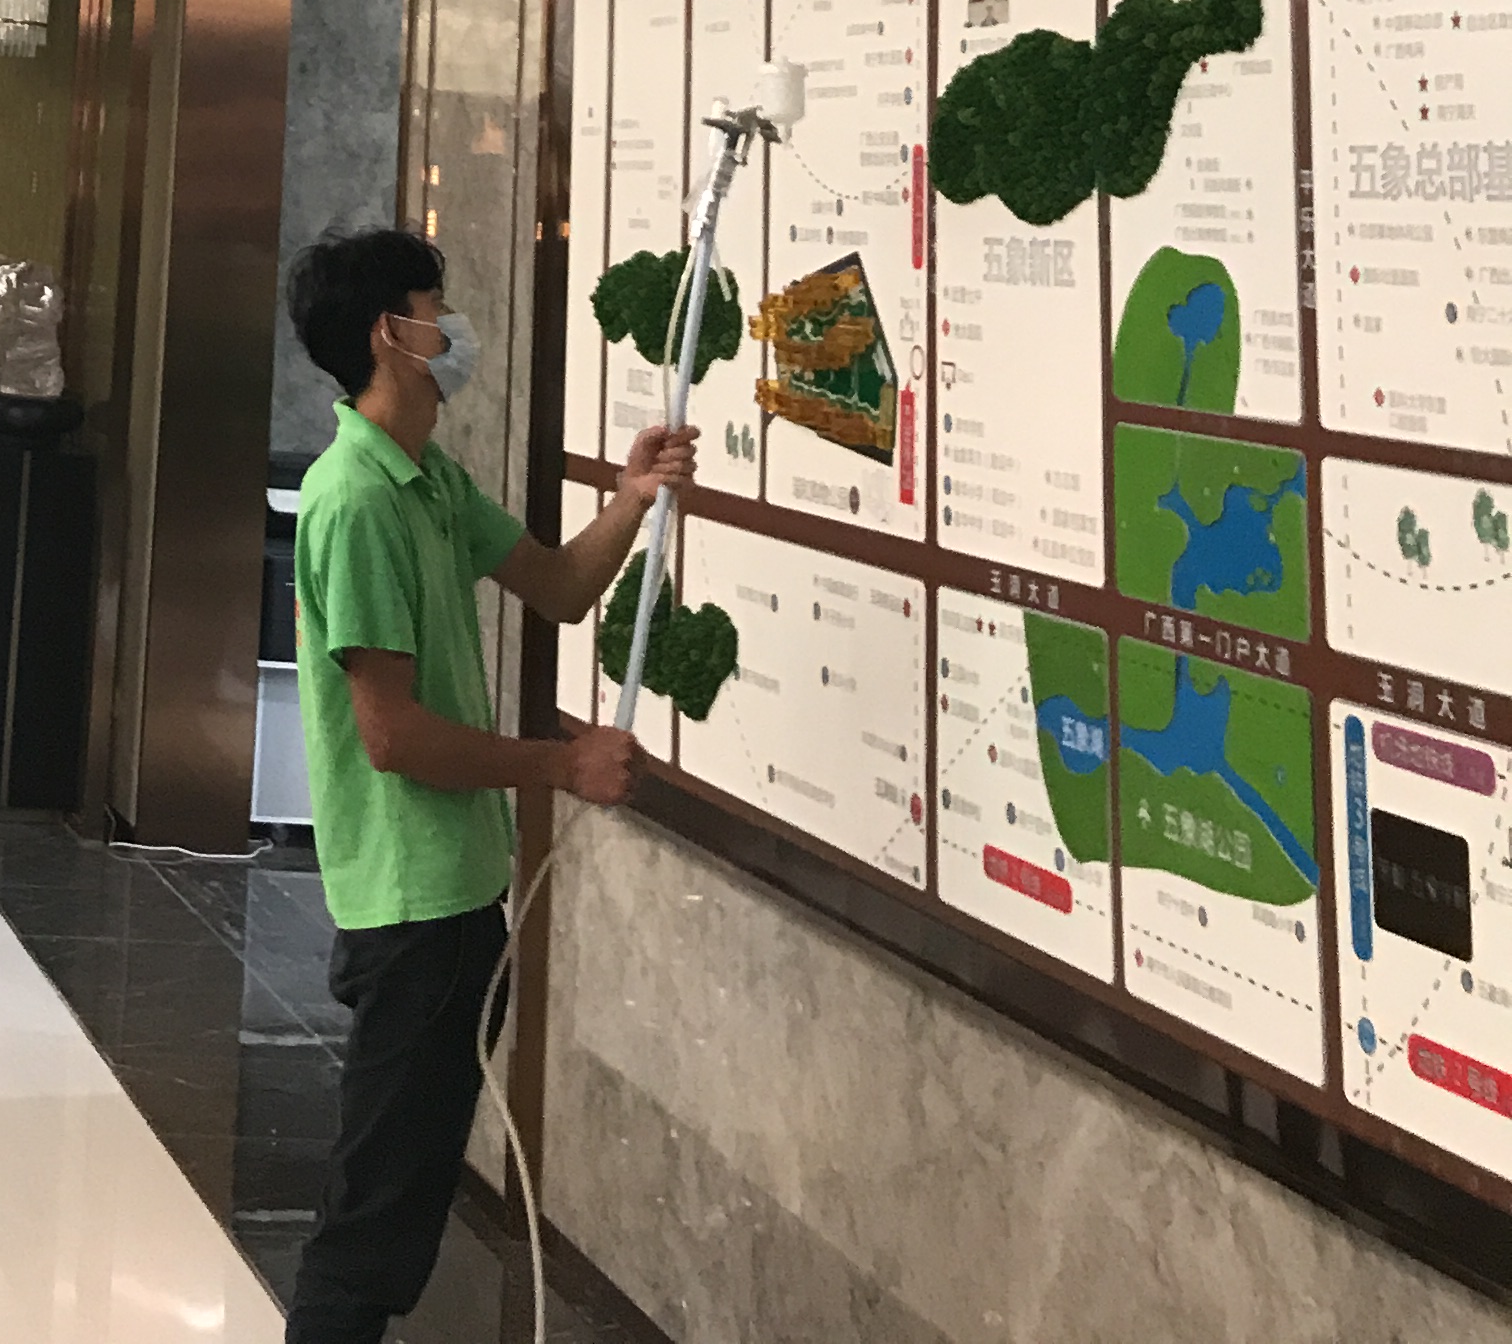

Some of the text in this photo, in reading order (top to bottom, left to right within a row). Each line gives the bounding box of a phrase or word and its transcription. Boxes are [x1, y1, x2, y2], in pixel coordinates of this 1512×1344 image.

[1348, 140, 1512, 203] 五象总部基
[982, 236, 1077, 289] 五象新区
